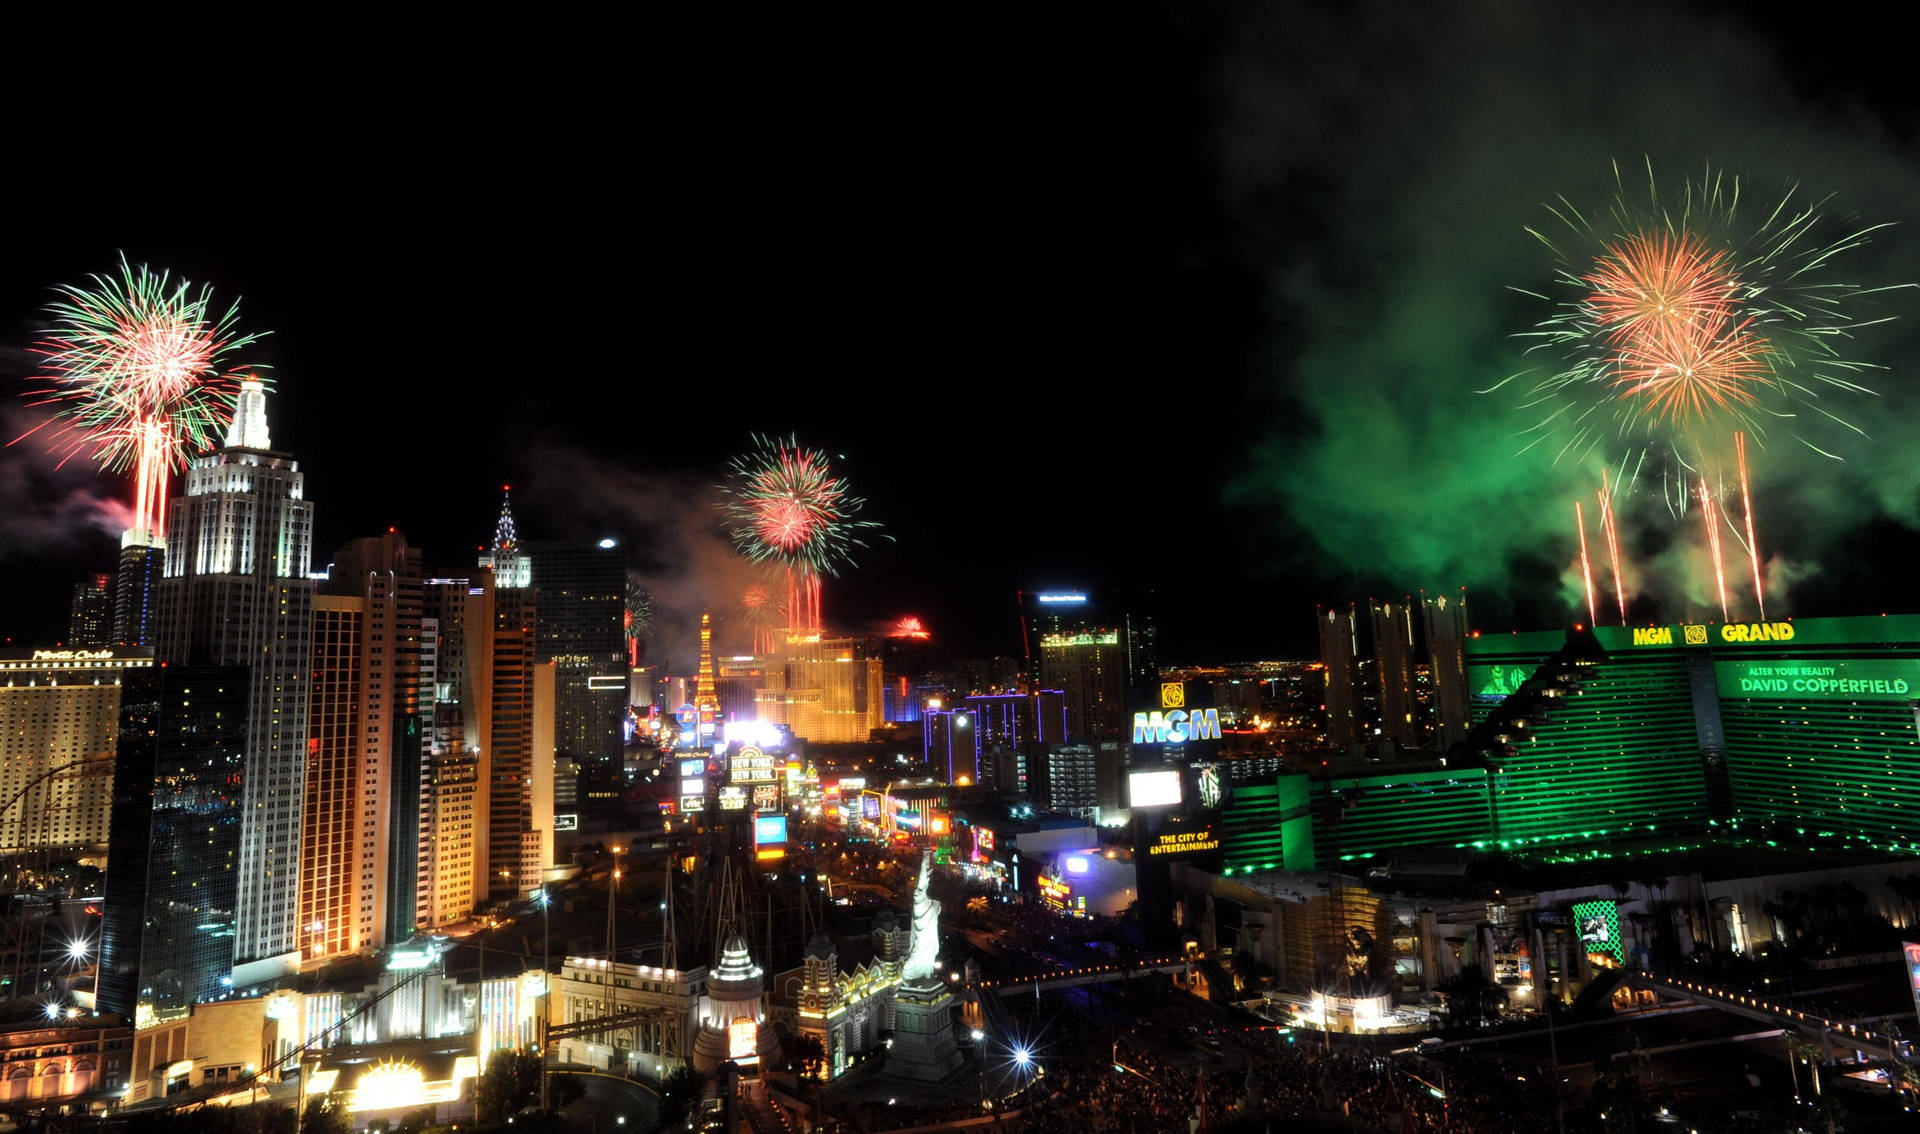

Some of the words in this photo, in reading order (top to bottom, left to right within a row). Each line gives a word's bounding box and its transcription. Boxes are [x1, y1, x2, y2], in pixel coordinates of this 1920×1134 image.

[1633, 627, 1673, 645] MGM
[1721, 622, 1795, 642] GRAND
[74, 649, 114, 660] Carlo
[1750, 667, 1773, 676] ALTER
[1775, 667, 1799, 676] YOUR
[1801, 667, 1836, 676] REALITY
[1741, 679, 1789, 691] DAVID
[1793, 679, 1909, 694] COPPERFIELD
[1133, 709, 1222, 744] MGM
[731, 758, 749, 769] NEW
[751, 758, 771, 768] YORK
[731, 769, 749, 780] NEW
[751, 769, 772, 779] YORK
[1160, 834, 1177, 844] THE
[1178, 833, 1196, 843] CITY
[1197, 831, 1209, 841] OF
[1150, 840, 1219, 855] ENTERTAINMENT
